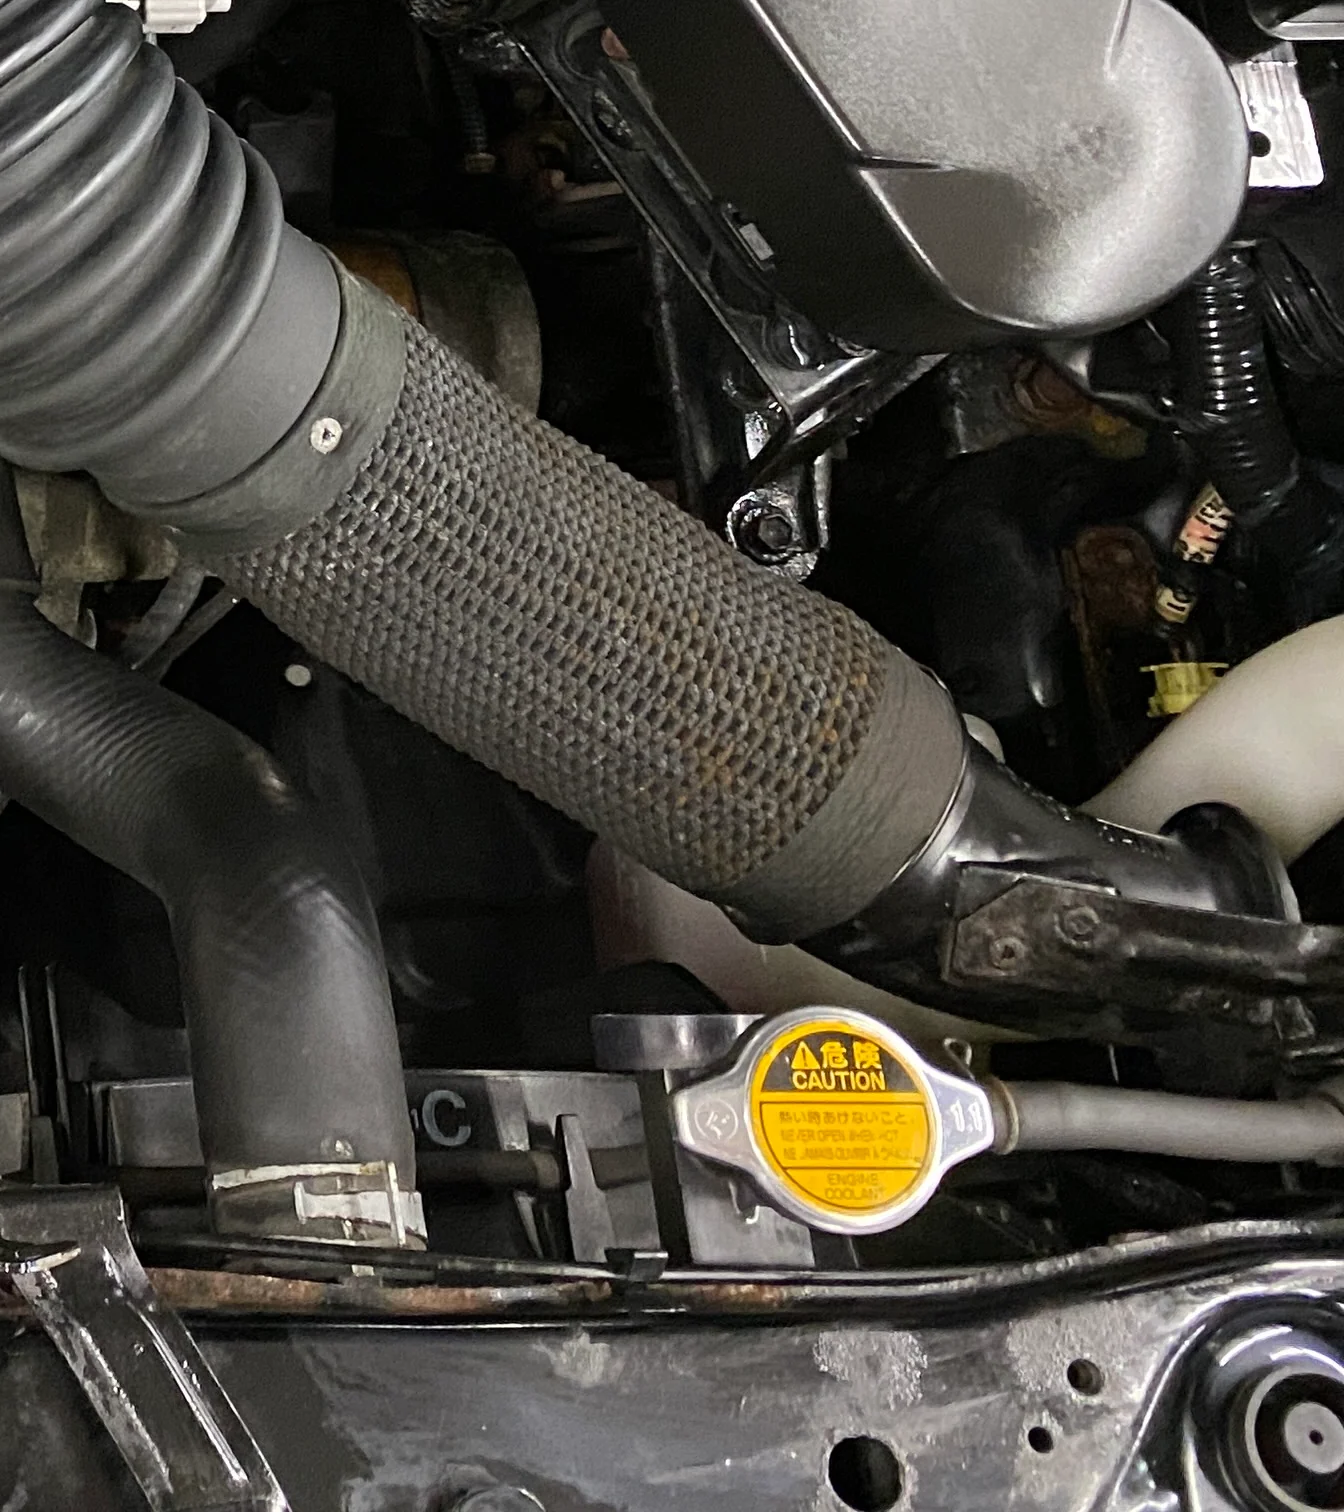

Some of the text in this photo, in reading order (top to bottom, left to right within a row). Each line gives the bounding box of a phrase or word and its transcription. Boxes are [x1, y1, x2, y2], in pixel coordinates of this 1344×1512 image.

[819, 1041, 883, 1069] 危険
[792, 1070, 886, 1091] CAUTION
[411, 1089, 472, 1146] C
[827, 1173, 879, 1187] ENGINE
